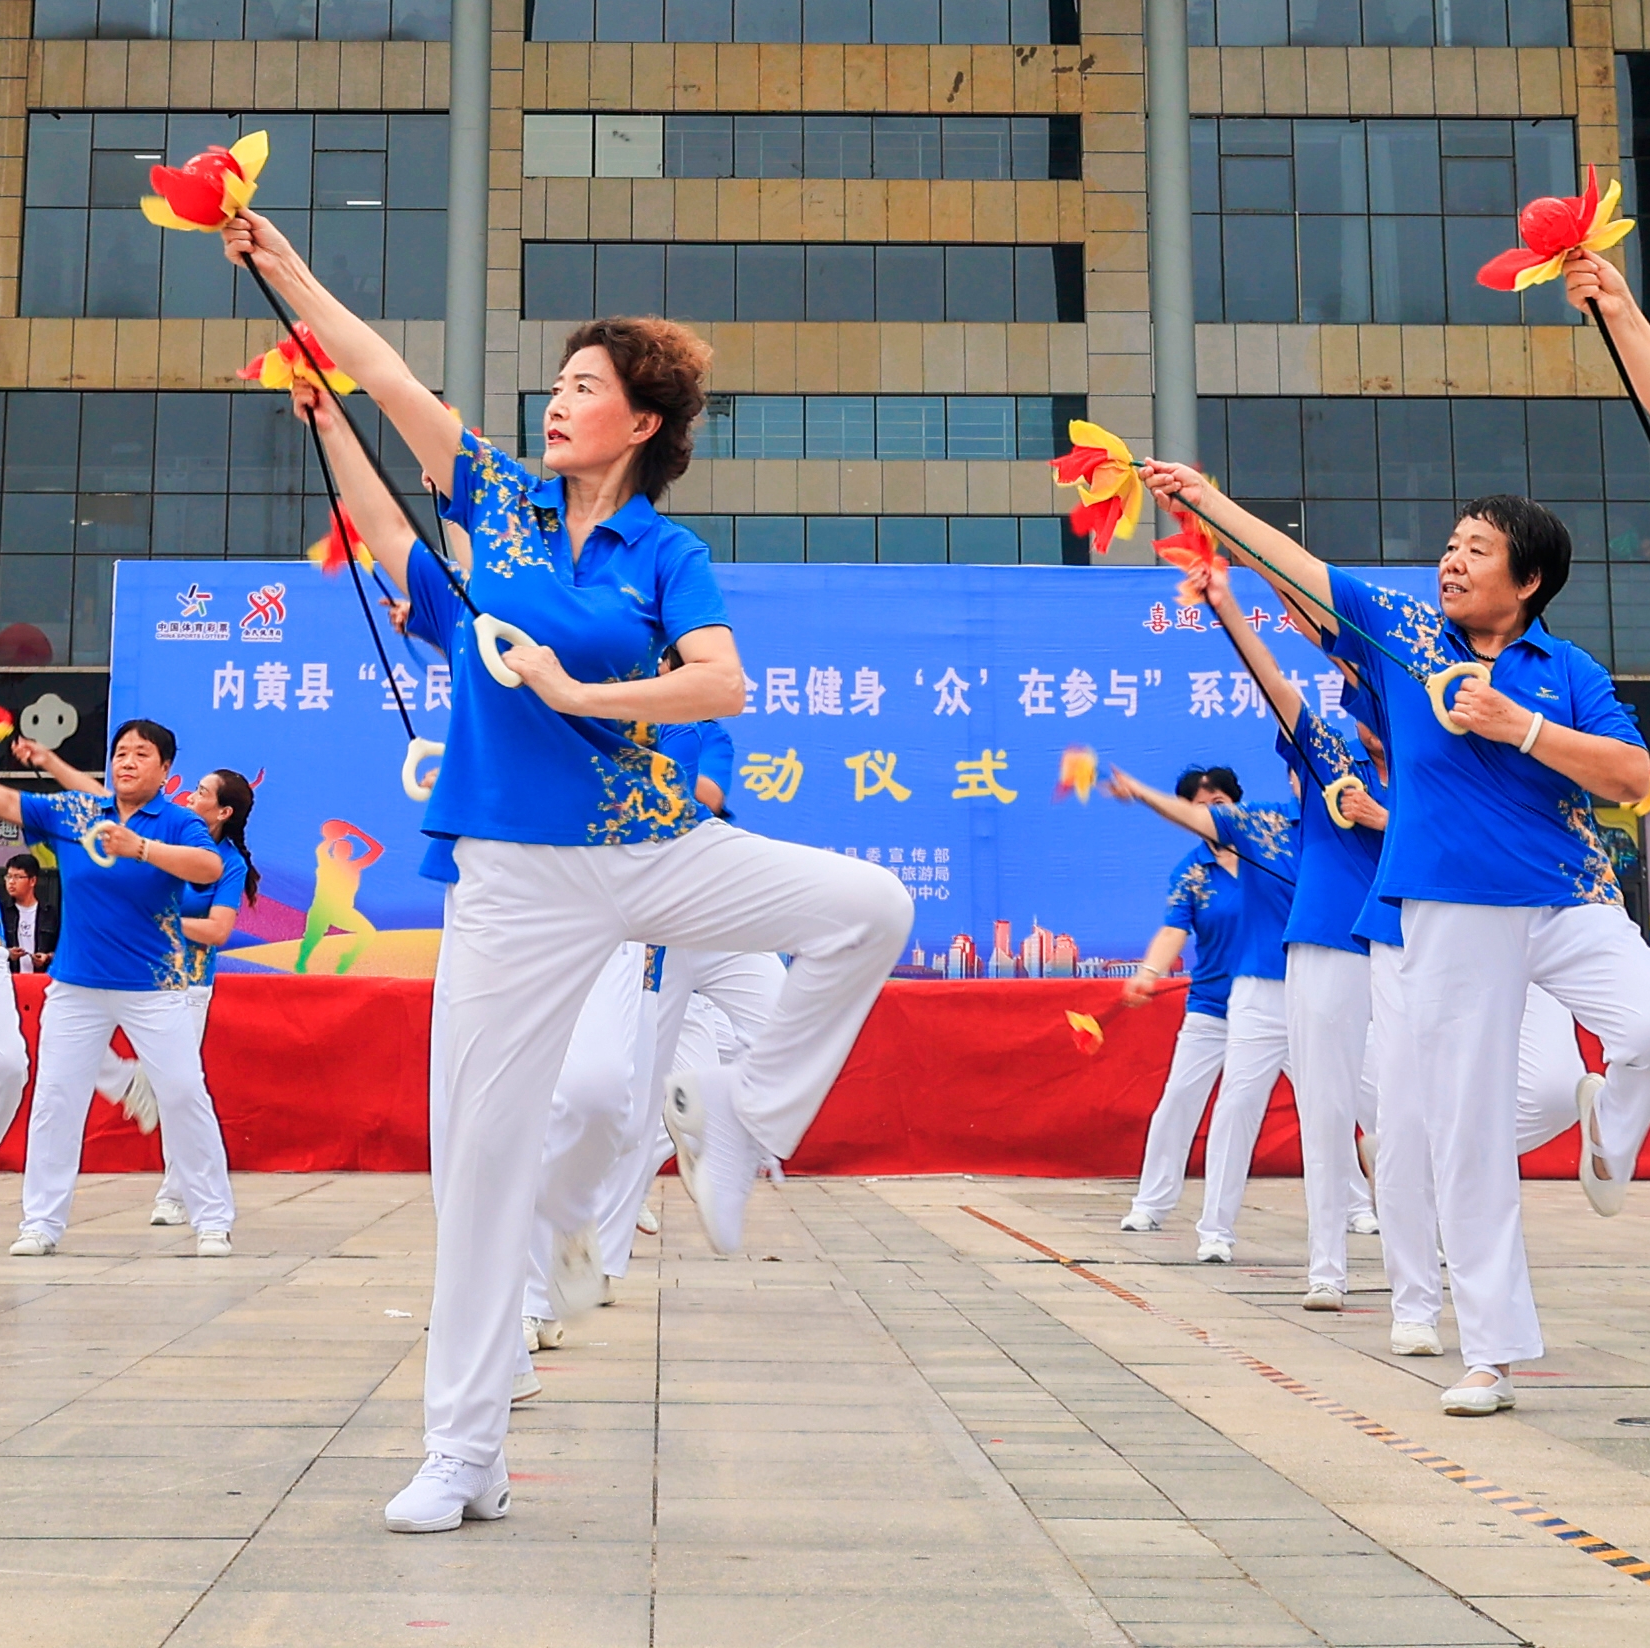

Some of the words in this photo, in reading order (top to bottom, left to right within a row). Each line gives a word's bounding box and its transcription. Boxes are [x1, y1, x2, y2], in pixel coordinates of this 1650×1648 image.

[157, 622, 229, 633] 中国体育彩票
[1144, 602, 1301, 634] 喜迎十大
[739, 748, 1018, 803] 动仪式
[824, 847, 950, 864] 县委宣传部
